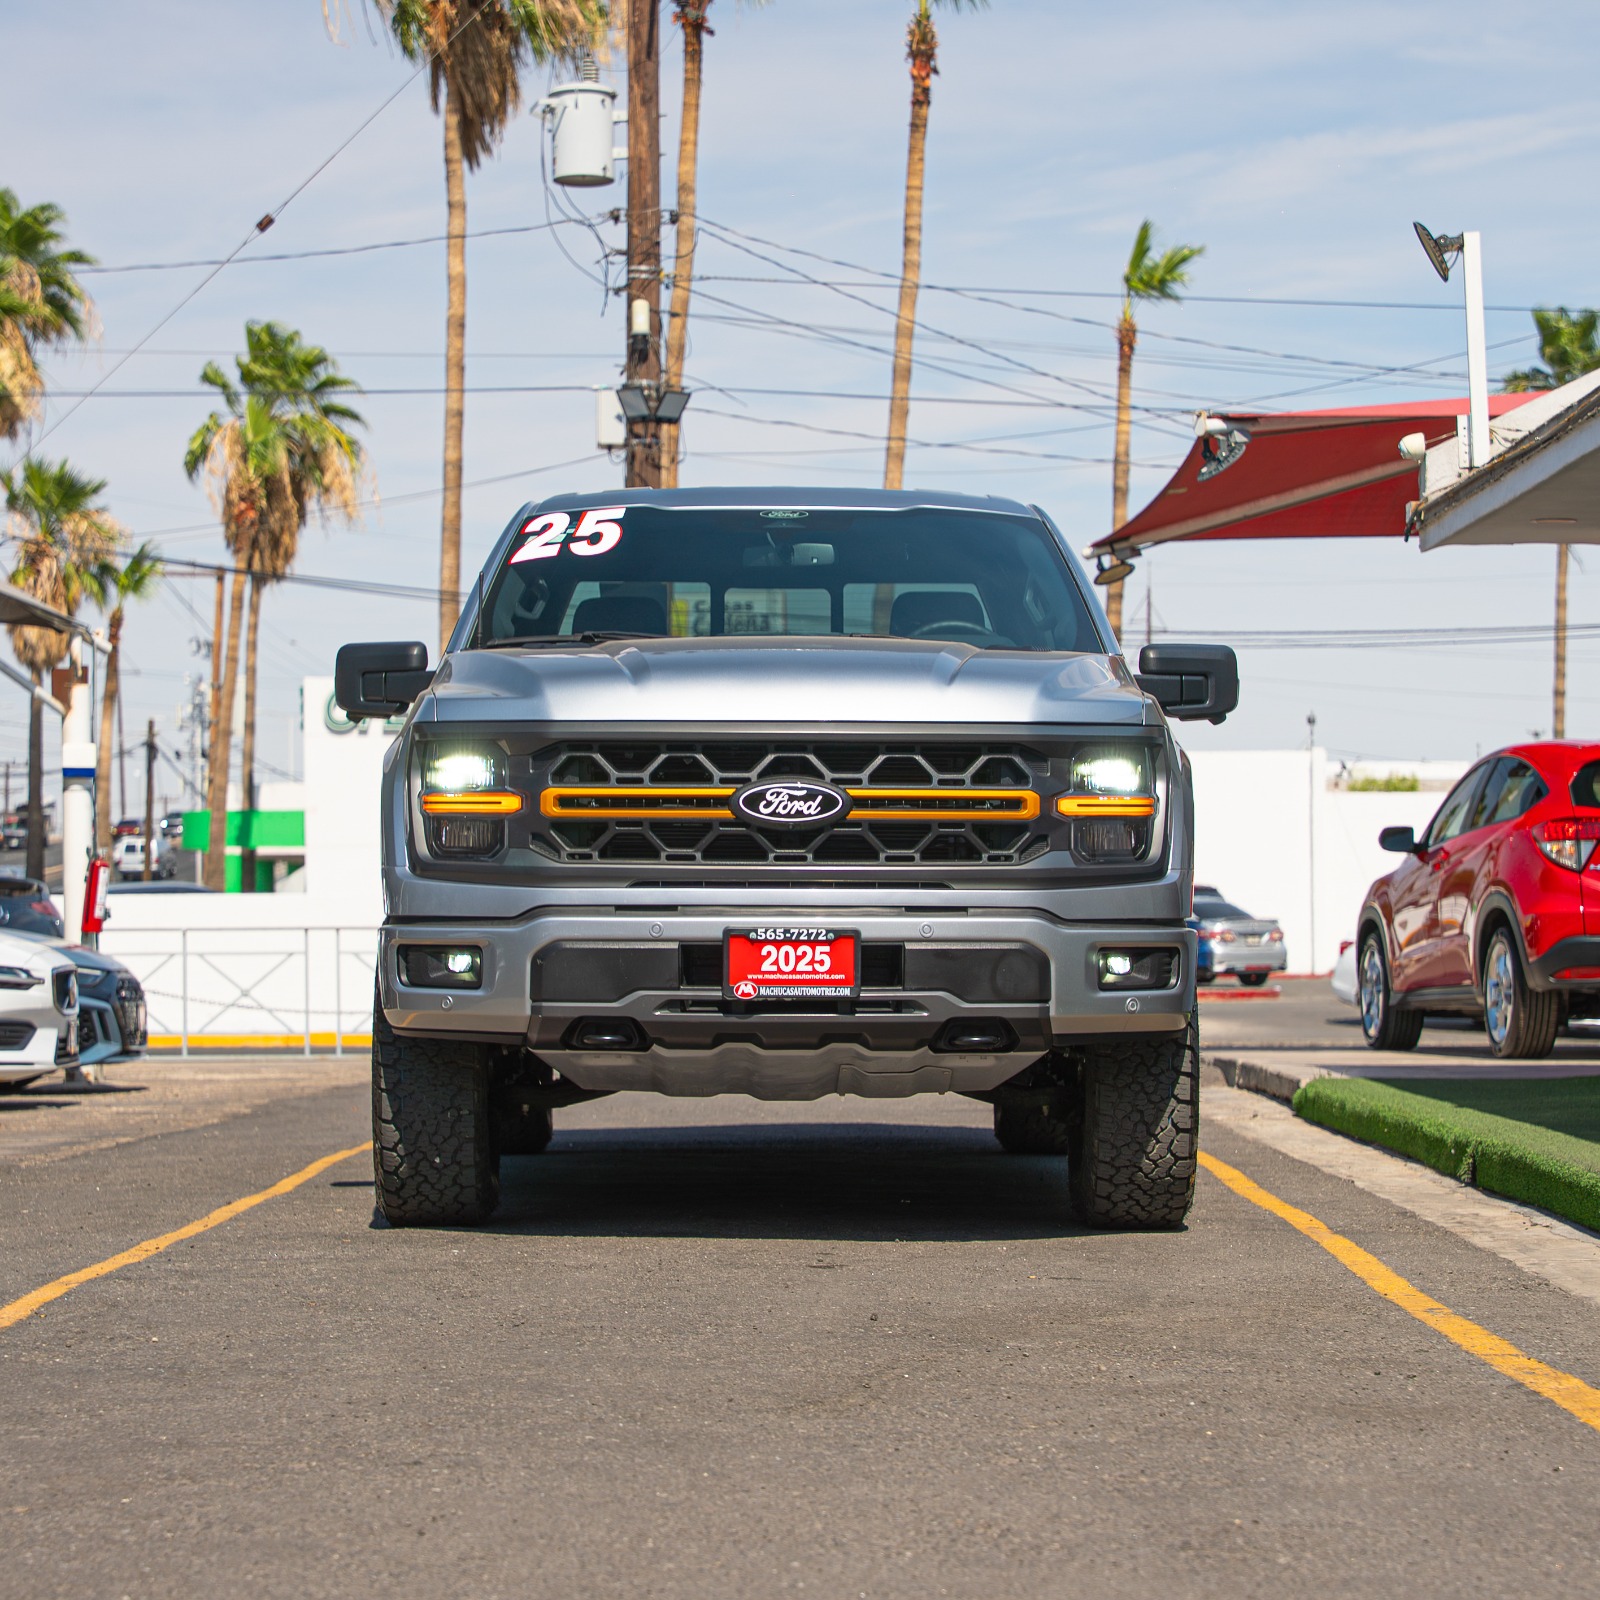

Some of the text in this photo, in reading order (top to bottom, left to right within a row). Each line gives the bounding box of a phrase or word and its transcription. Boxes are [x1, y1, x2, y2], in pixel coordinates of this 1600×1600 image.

[508, 507, 627, 565] 25
[759, 788, 823, 815] Ford
[757, 928, 827, 940] 565-7272
[760, 945, 831, 972] 2025
